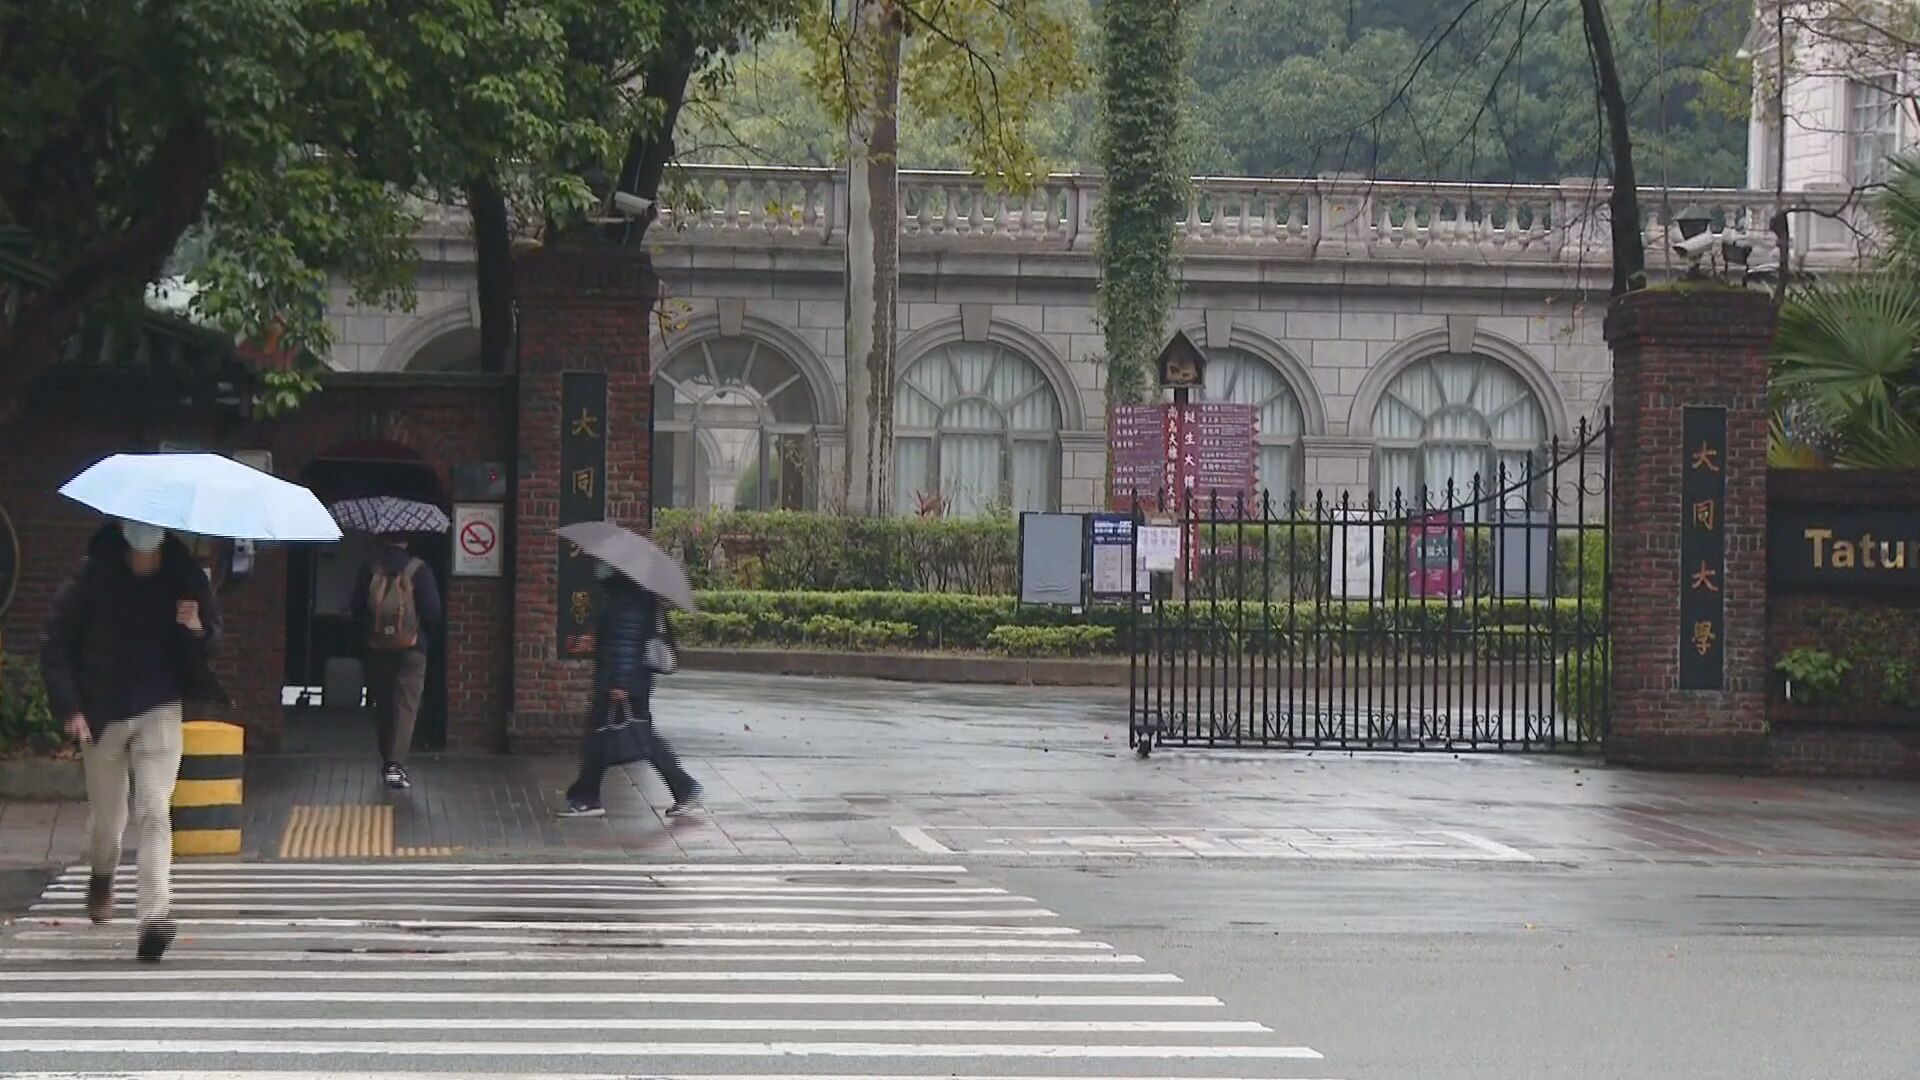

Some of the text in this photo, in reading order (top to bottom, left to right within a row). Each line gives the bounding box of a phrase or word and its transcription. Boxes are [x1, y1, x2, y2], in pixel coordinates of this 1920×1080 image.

[570, 408, 599, 625] 大同學
[1691, 440, 1720, 655] 大同大學
